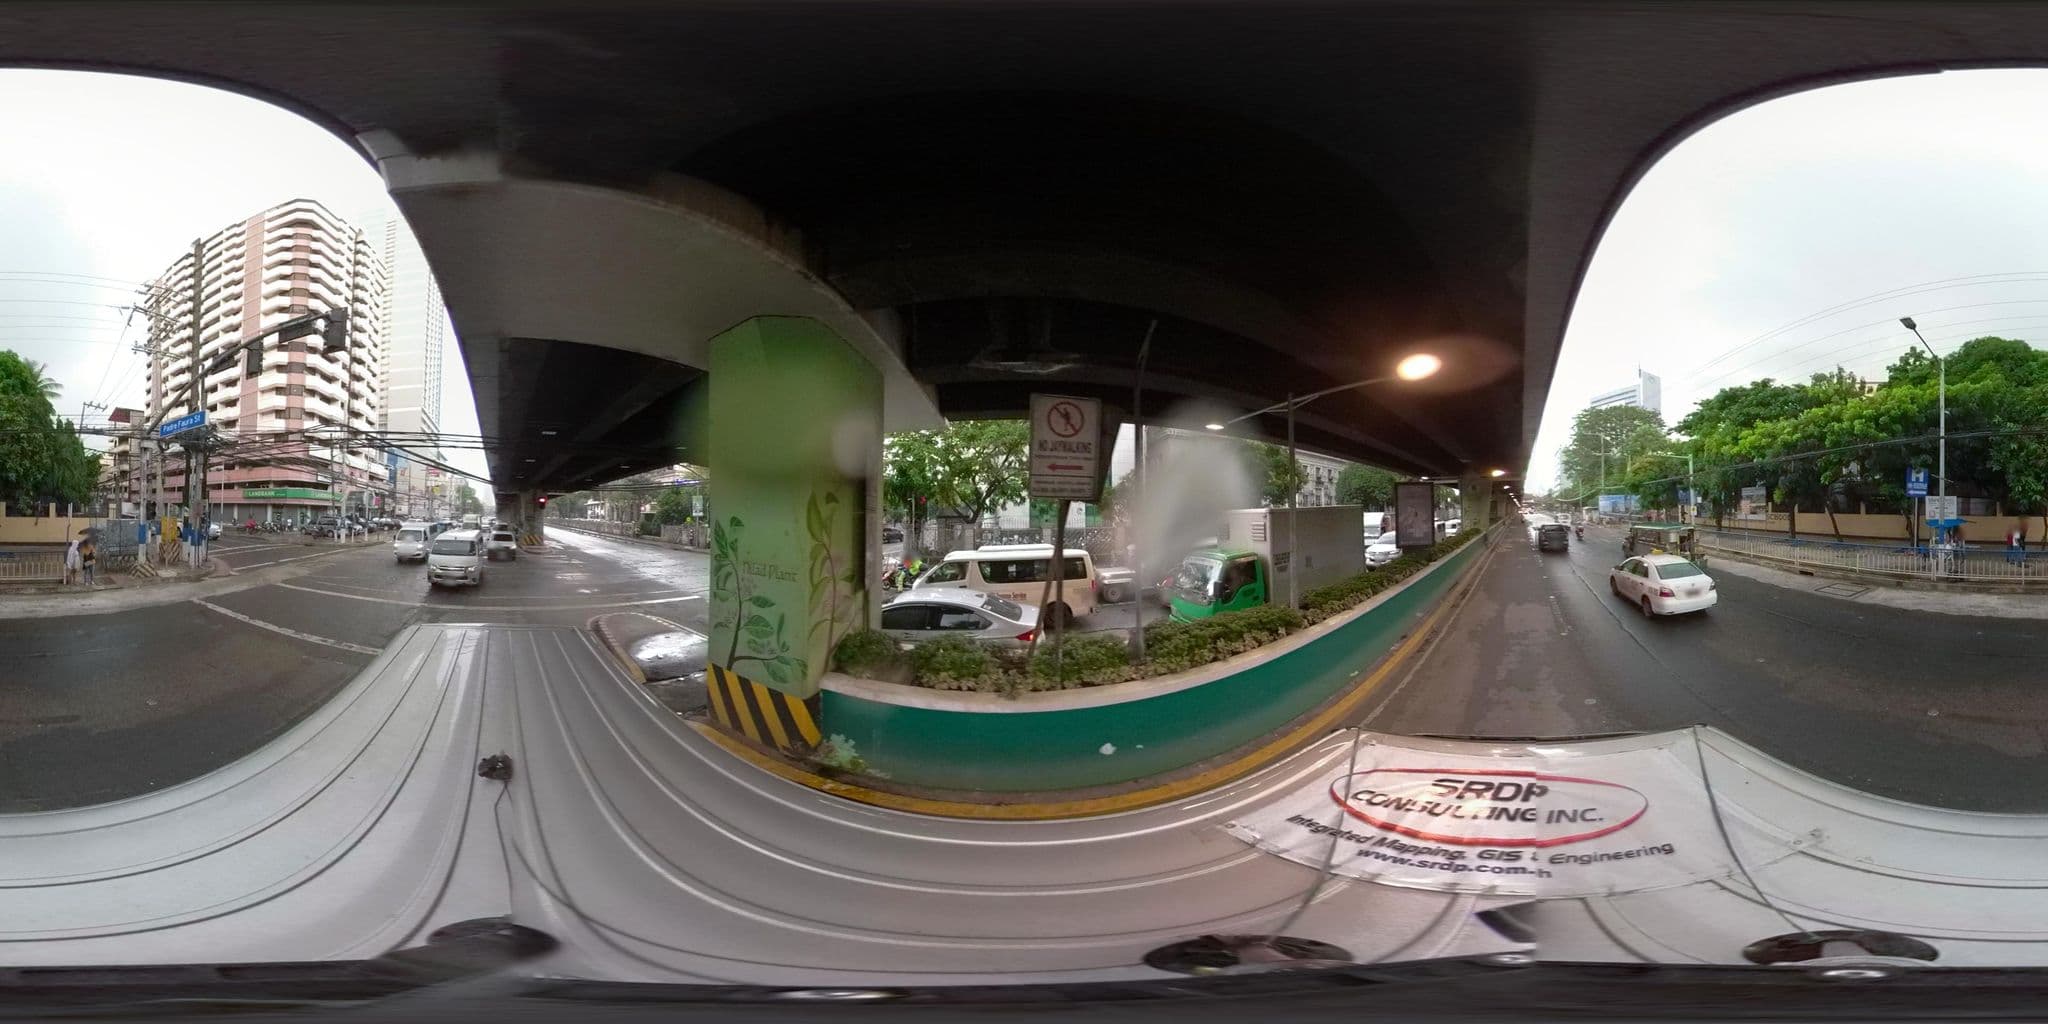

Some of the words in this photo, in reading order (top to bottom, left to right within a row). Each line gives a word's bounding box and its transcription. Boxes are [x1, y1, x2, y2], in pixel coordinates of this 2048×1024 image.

[162, 423, 177, 432] Padre
[177, 419, 194, 428] Faura
[194, 414, 201, 423] St
[1038, 440, 1048, 451] NO
[1431, 778, 1549, 803] SRDP
[1545, 808, 1604, 824] INC.
[1286, 814, 1375, 844] Integrated
[1477, 849, 1524, 862] GIS
[1550, 843, 1675, 865] Engineering
